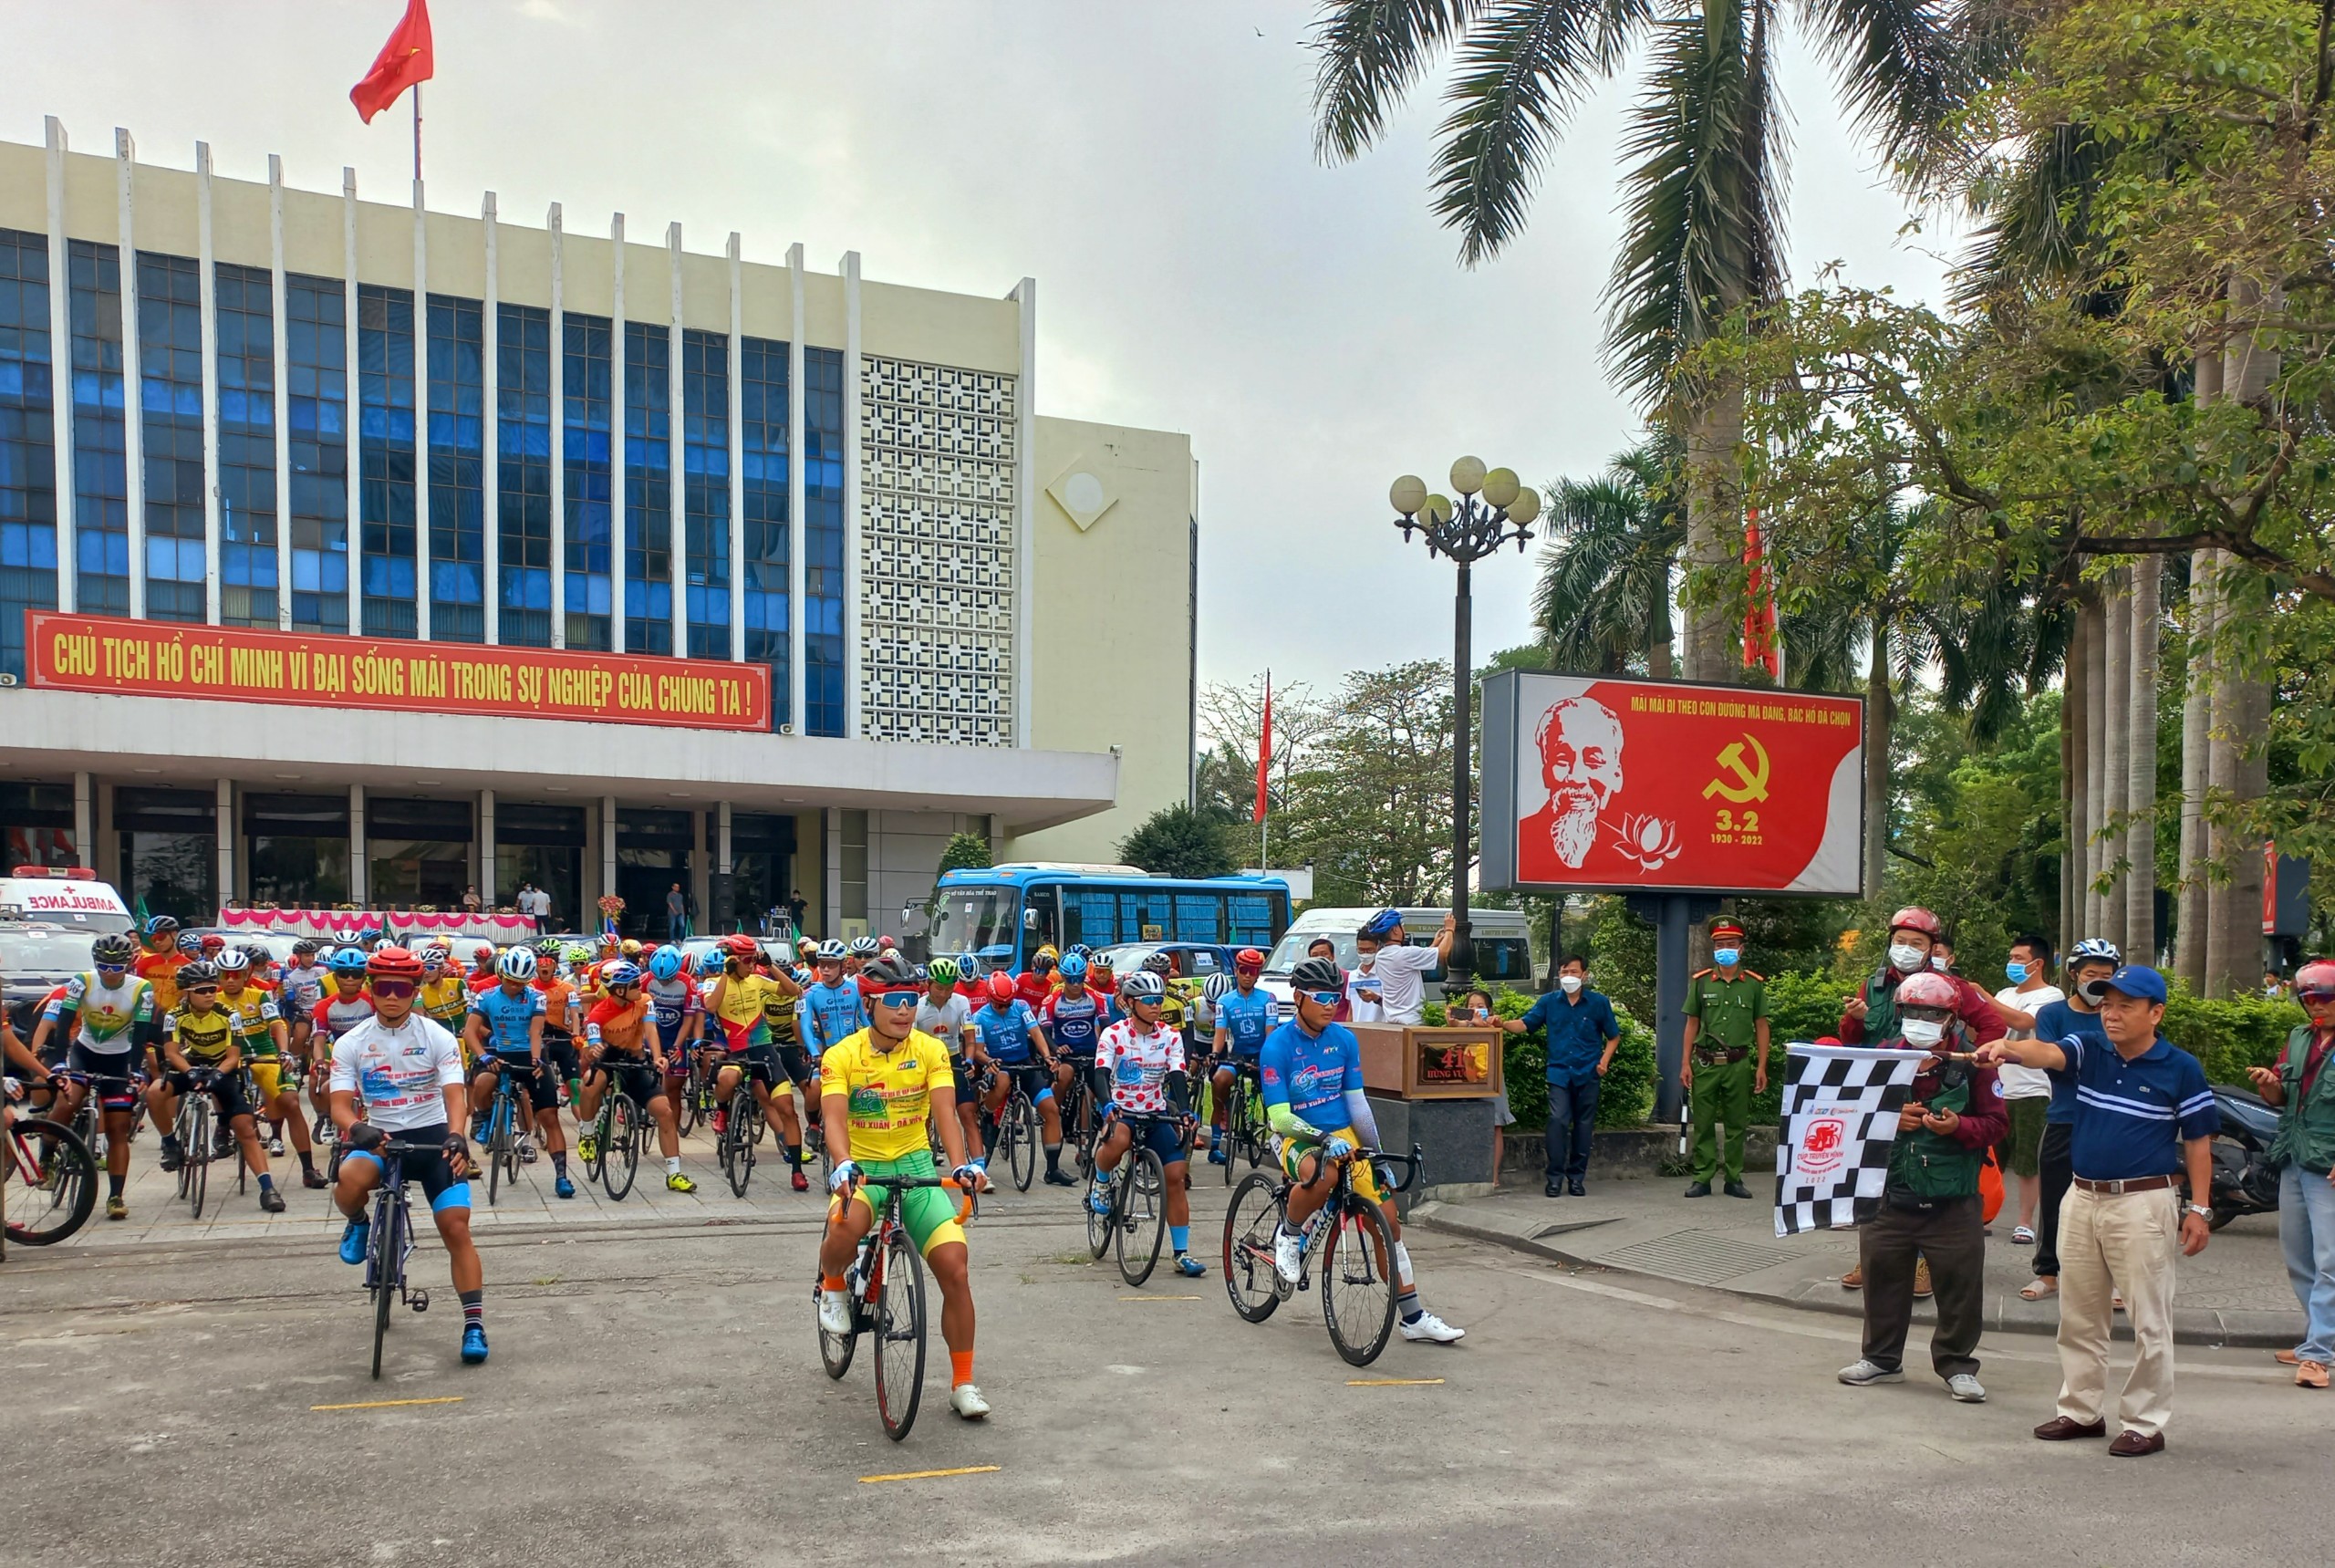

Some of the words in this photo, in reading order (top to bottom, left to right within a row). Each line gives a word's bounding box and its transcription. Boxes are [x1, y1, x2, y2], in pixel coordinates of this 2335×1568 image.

[54, 627, 97, 675] CHỦ
[103, 638, 150, 684] TỊCH
[157, 631, 183, 682] HỒ
[191, 639, 223, 686] CHÍ
[231, 648, 283, 690] MINH
[289, 646, 308, 691] VĨ
[314, 653, 346, 698] ĐẠI
[352, 646, 404, 696] SỐNG
[410, 654, 446, 699] MÃI
[451, 661, 512, 701] TRONG
[517, 665, 544, 710] SỰ
[548, 664, 612, 712] NGHIỆP
[618, 664, 653, 711] CỦA
[658, 670, 715, 714] CHÚNG
[720, 680, 741, 716] TA
[745, 681, 751, 716] !
[1667, 699, 1676, 713] ĐI
[1677, 700, 1697, 715] THEO
[1699, 701, 1716, 716] CON
[1718, 699, 1746, 718] ĐƯỜNG
[1830, 711, 1851, 729] CHỌN
[1716, 810, 1759, 832] 3.2
[1710, 833, 1732, 844] 1930
[1741, 835, 1762, 846] 2022
[263, 1005, 275, 1015] 53
[1269, 1005, 1277, 1013] 13
[1312, 1214, 1334, 1251] GIANT
